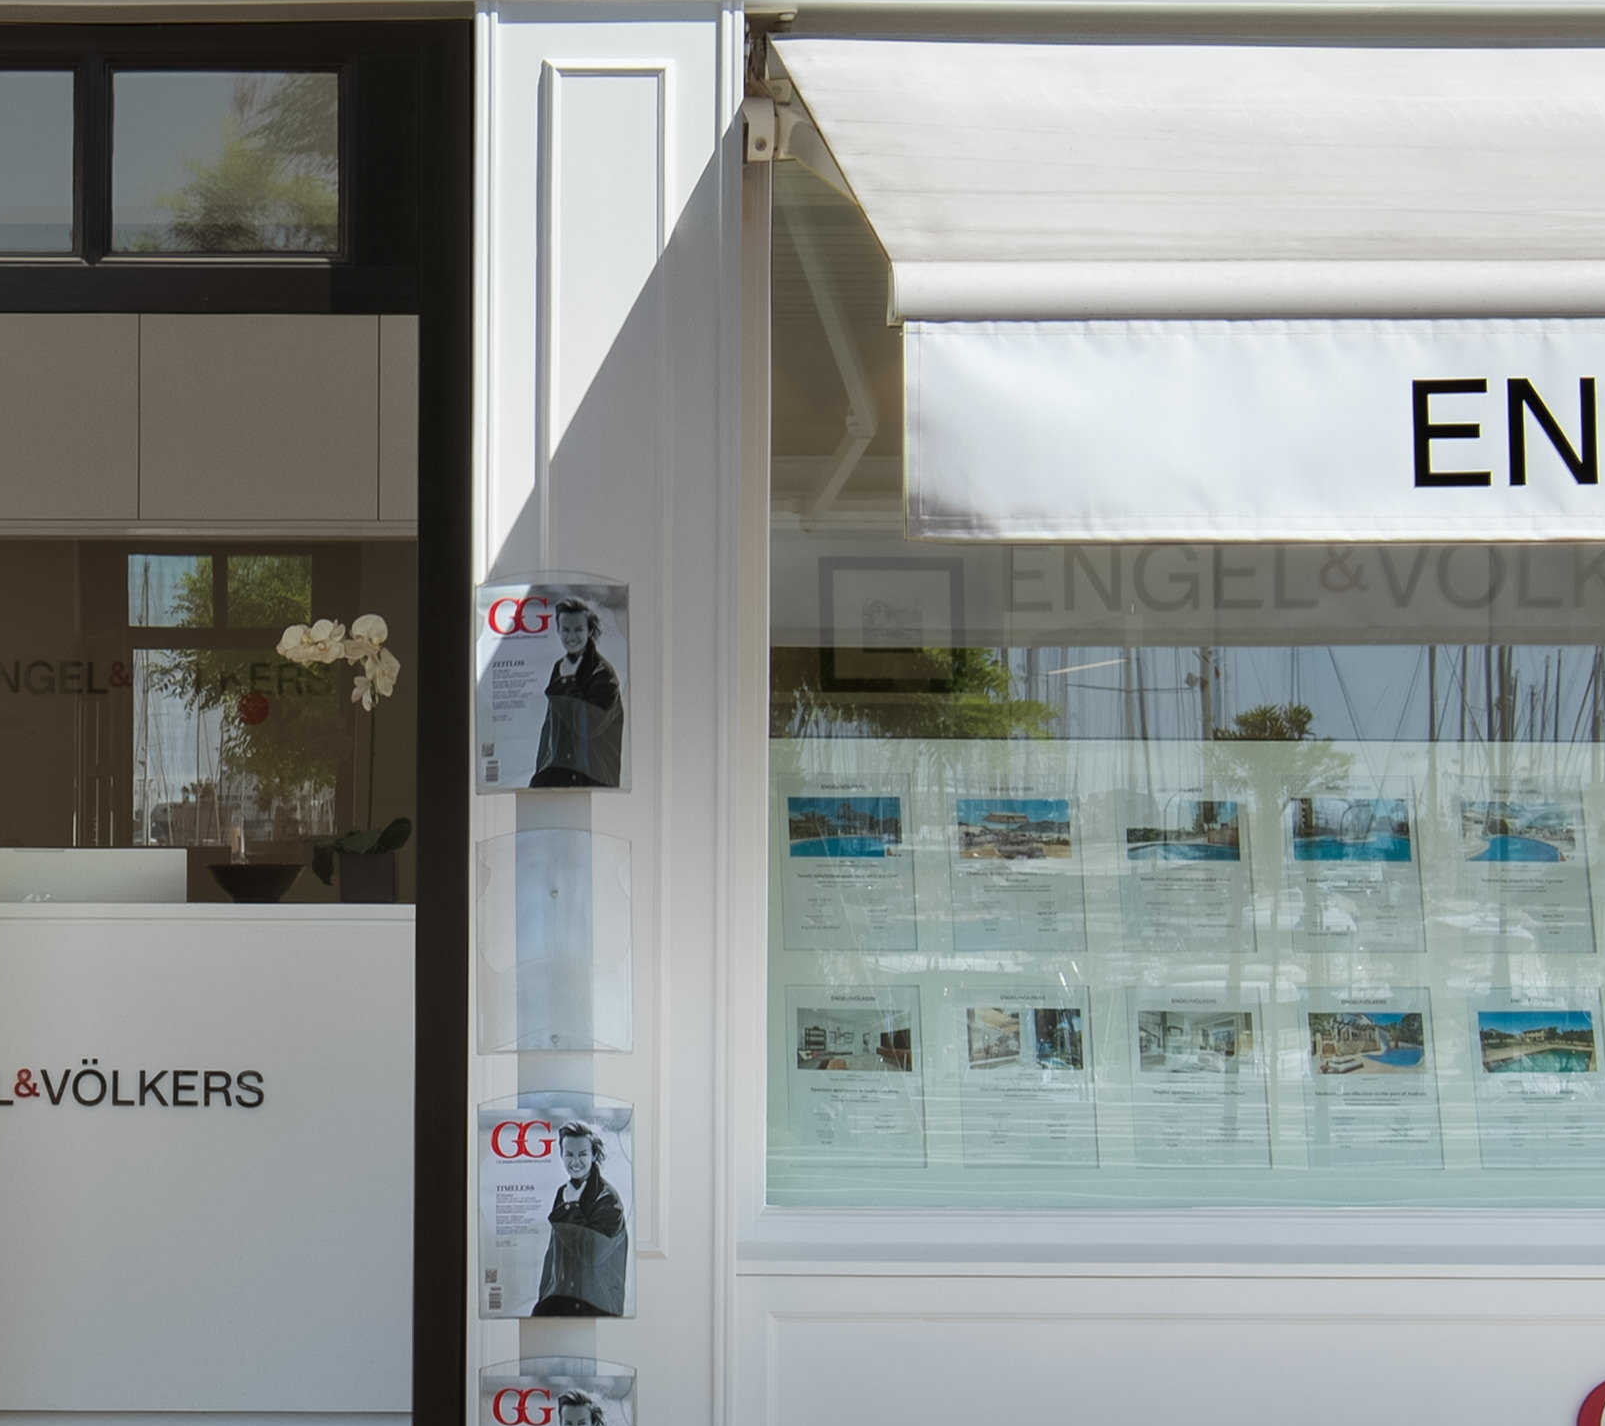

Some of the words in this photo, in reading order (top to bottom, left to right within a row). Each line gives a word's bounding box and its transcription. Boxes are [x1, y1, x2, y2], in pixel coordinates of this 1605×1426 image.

[488, 596, 552, 635] GG
[490, 1120, 555, 1159] GG
[496, 1184, 535, 1192] TIMELESS
[492, 1387, 555, 1426] GG
